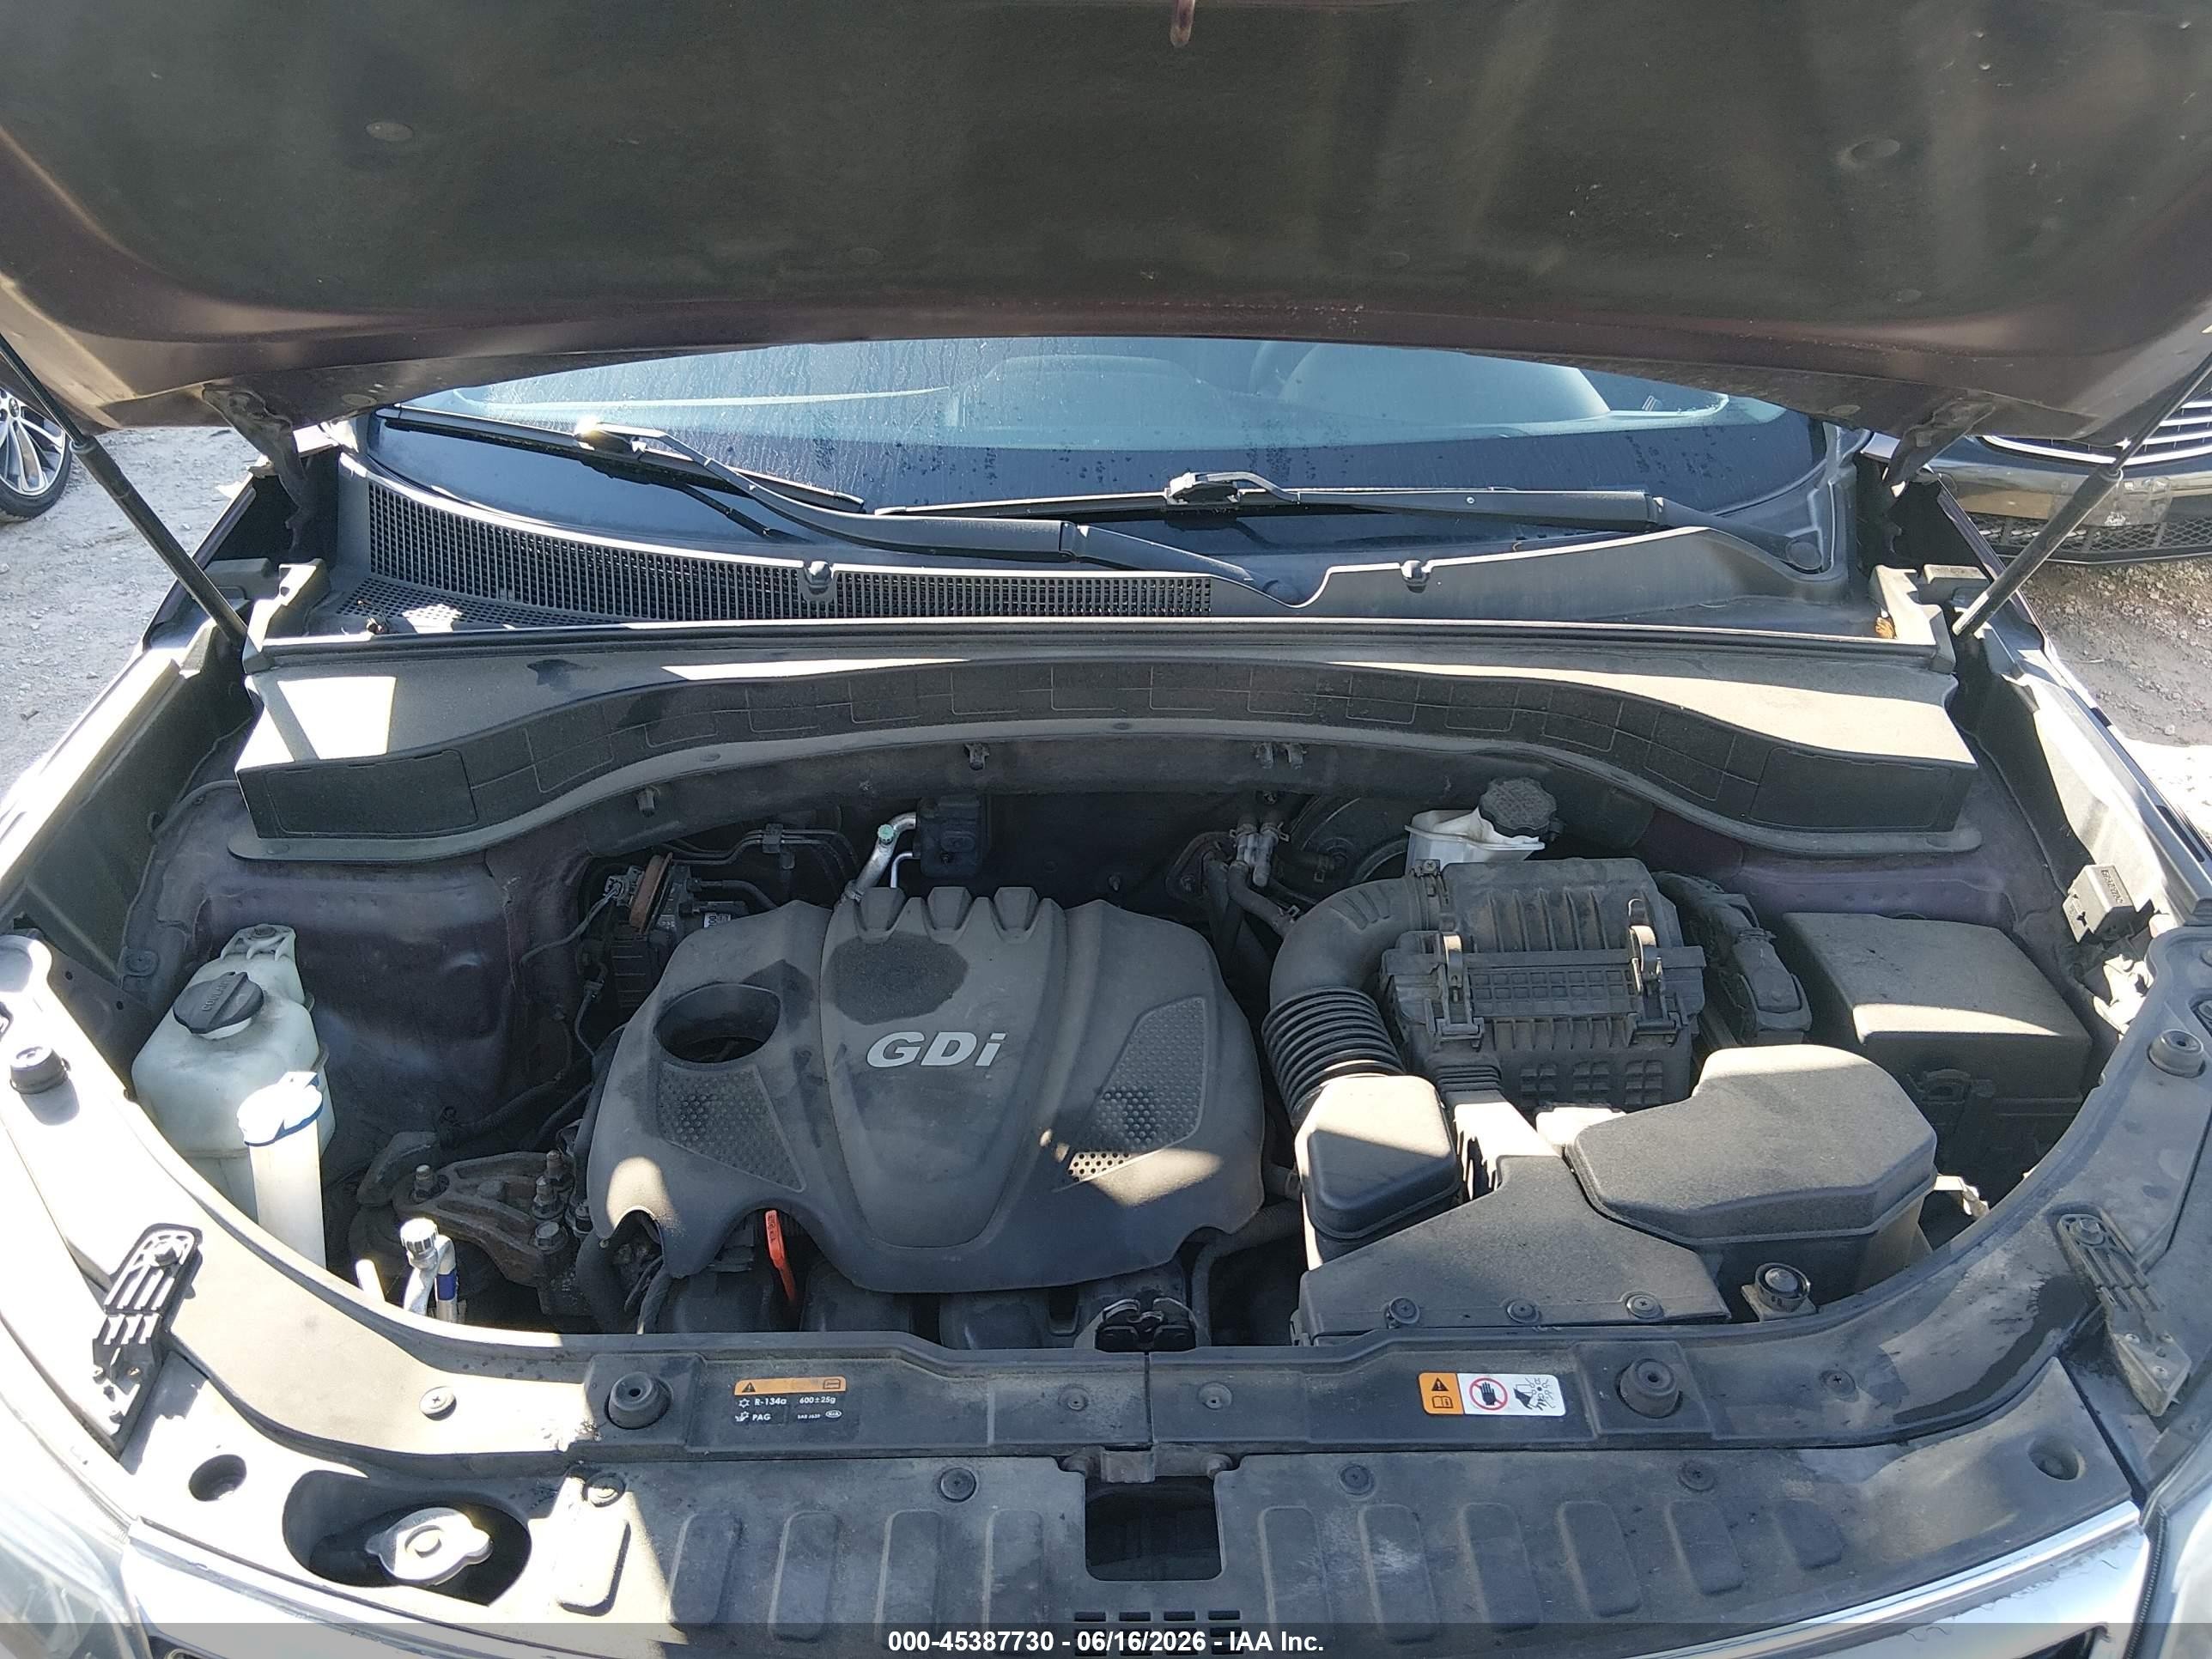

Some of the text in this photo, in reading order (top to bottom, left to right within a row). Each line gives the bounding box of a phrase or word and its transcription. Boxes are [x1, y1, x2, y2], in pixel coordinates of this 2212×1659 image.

[866, 1031, 1006, 1068] GDi
[754, 1397, 787, 1406] R-134a
[752, 1413, 772, 1421] PAG
